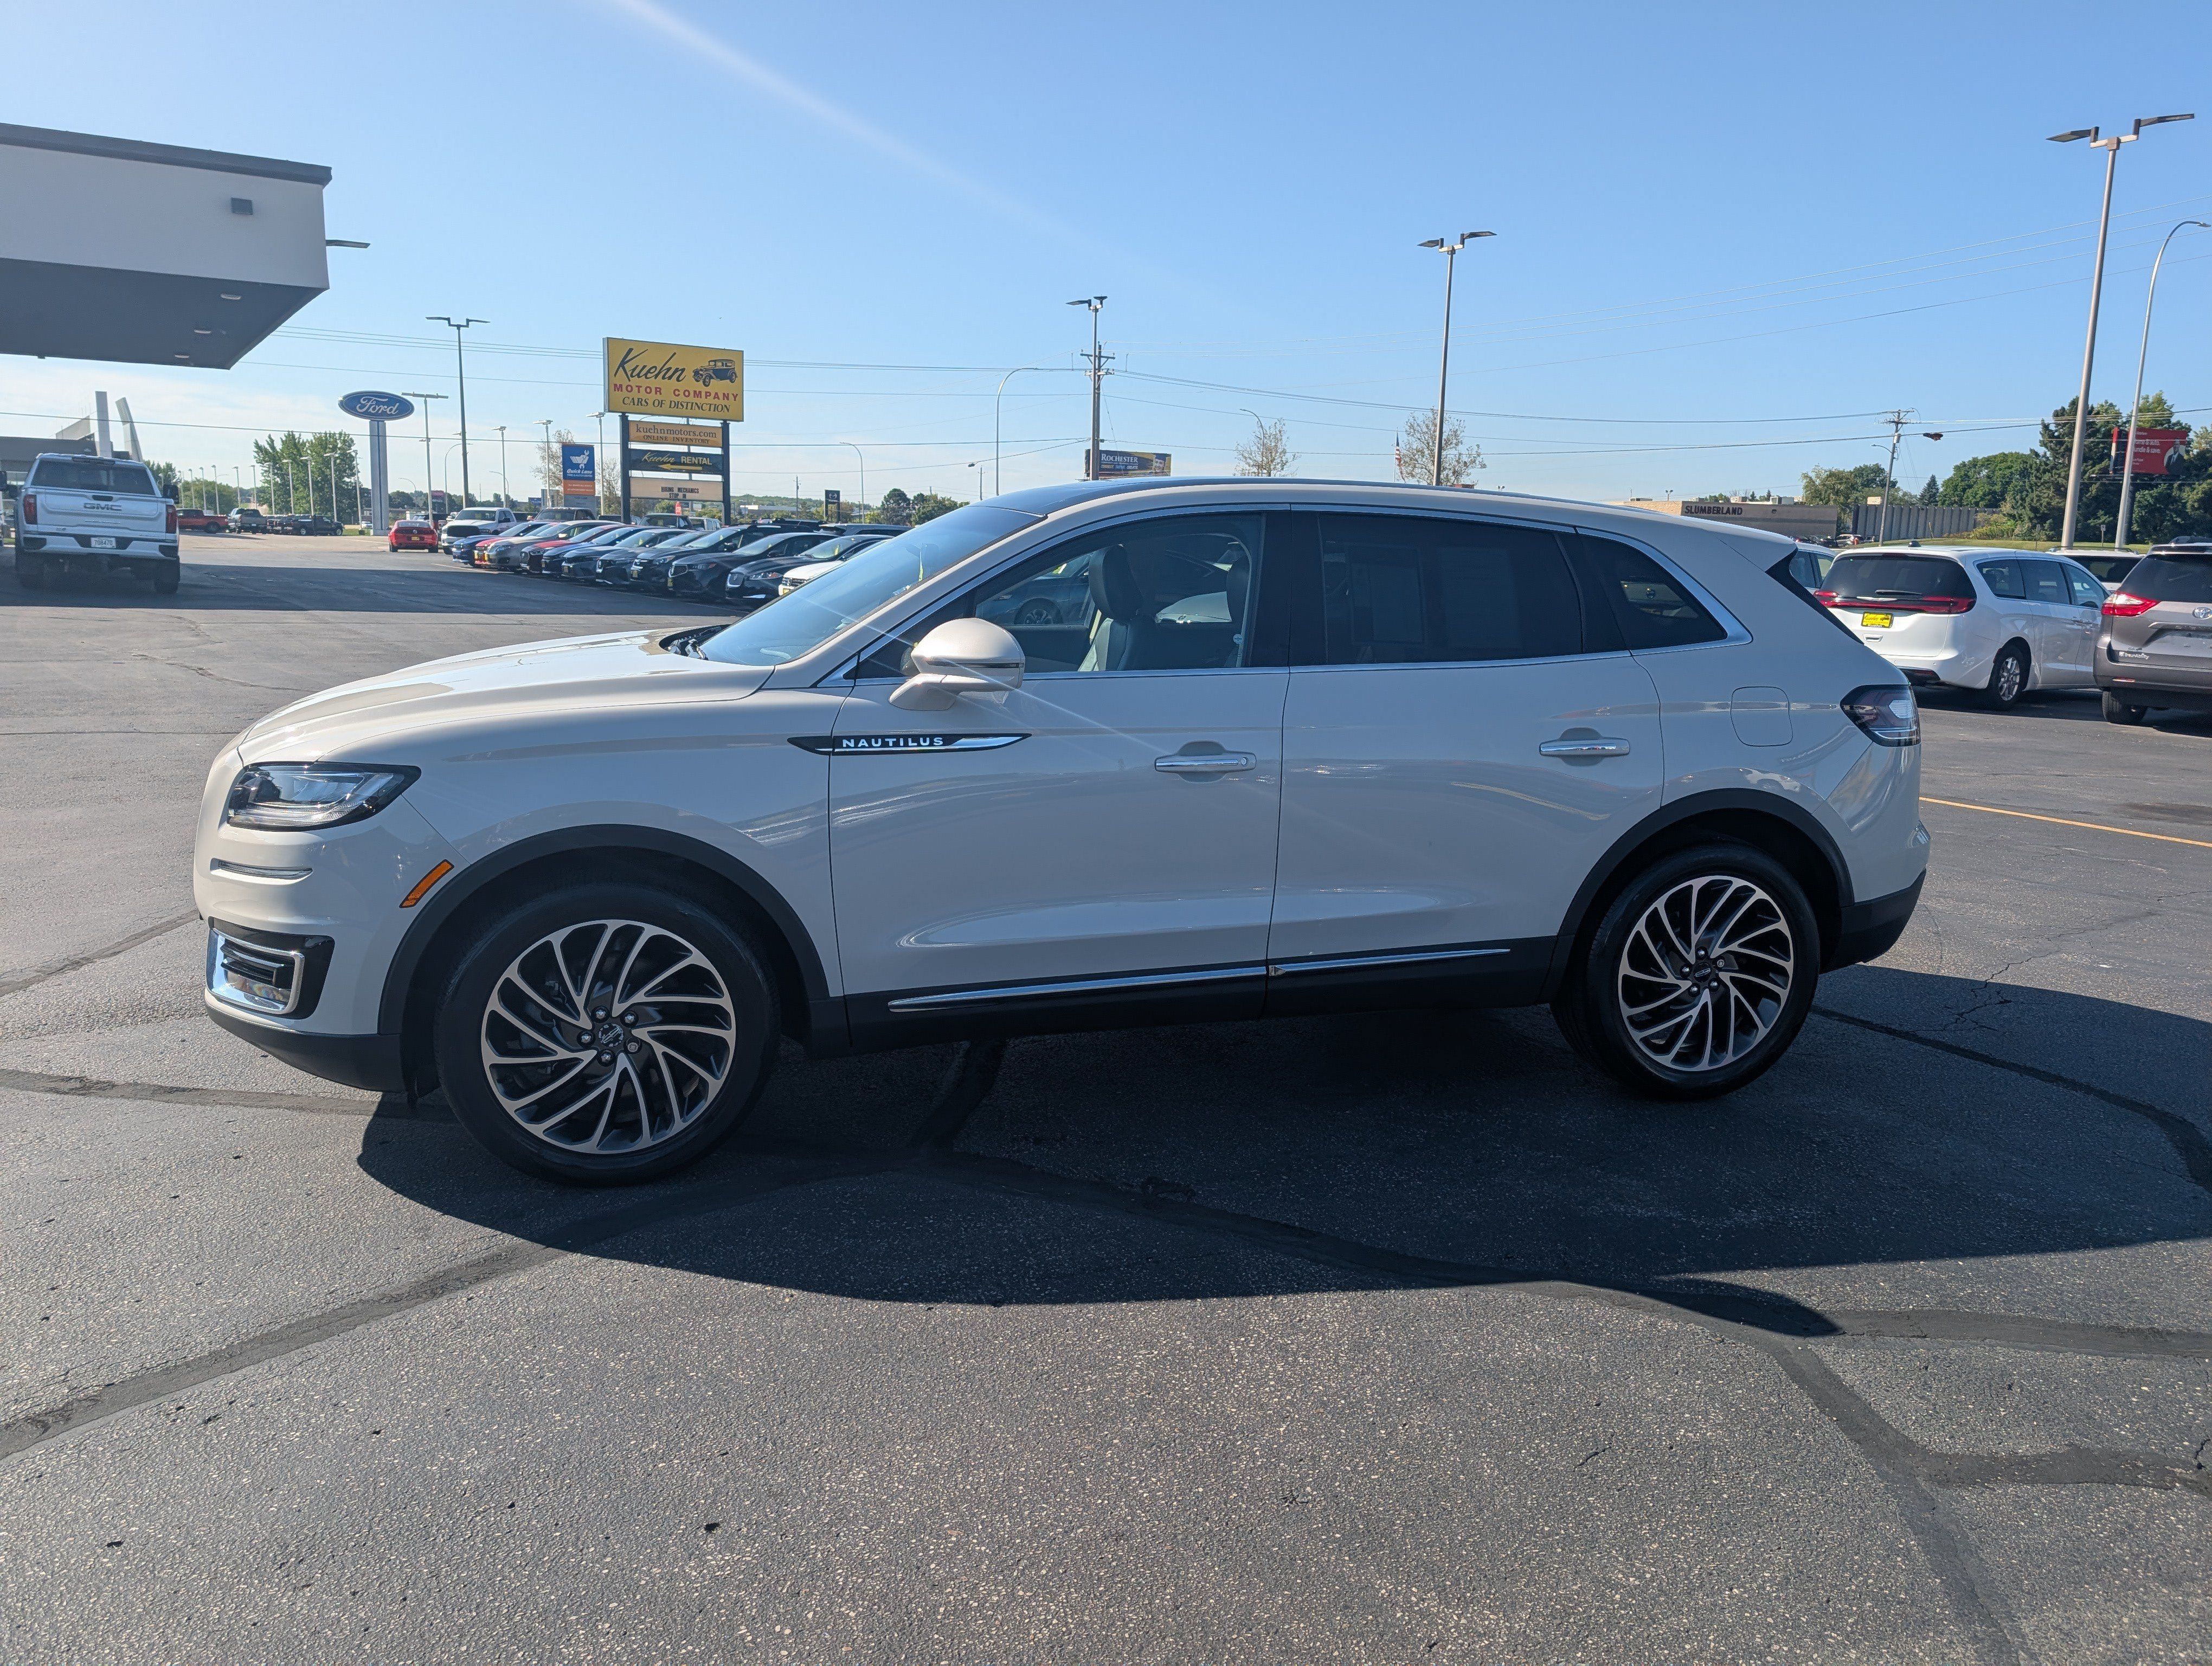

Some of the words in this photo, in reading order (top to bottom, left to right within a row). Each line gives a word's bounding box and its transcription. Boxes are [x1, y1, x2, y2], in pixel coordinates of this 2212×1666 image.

[614, 348, 686, 382] Kuehn
[613, 383, 662, 395] MOTOR
[673, 388, 738, 401] COMPANY
[356, 396, 400, 414] Ford
[622, 396, 649, 407] CARS
[652, 399, 666, 408] OF
[668, 400, 730, 412] DISTINCTION
[635, 424, 717, 438] kuehnmotors.com
[642, 452, 675, 463] Kuehn
[681, 456, 712, 465] RENTAL
[83, 503, 122, 511] GMC
[1684, 505, 1743, 515] SLUMBERLAND
[842, 736, 944, 748] NAUTILUS
